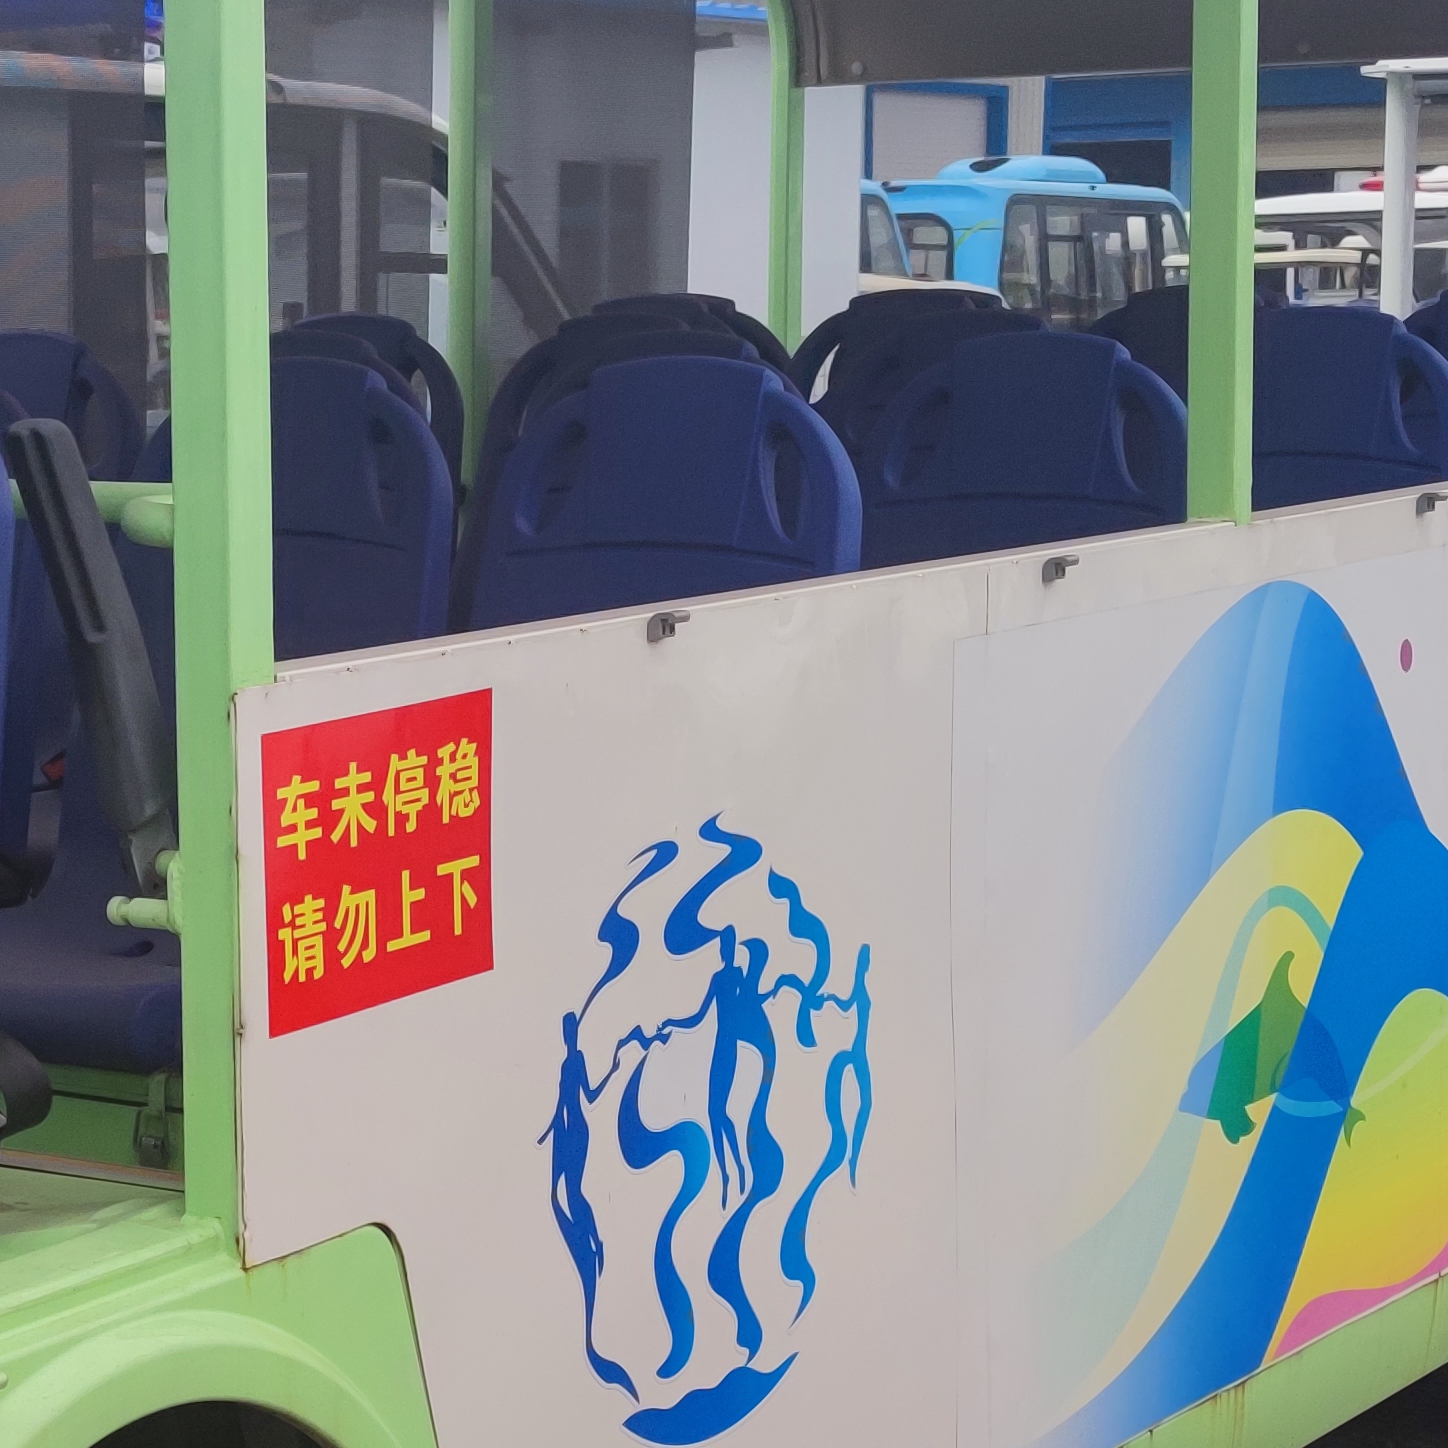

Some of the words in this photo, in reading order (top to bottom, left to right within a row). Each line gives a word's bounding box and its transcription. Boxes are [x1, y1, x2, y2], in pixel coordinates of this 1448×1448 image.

[276, 738, 481, 860] 车未停稳
[278, 855, 481, 984] 请勿上下
